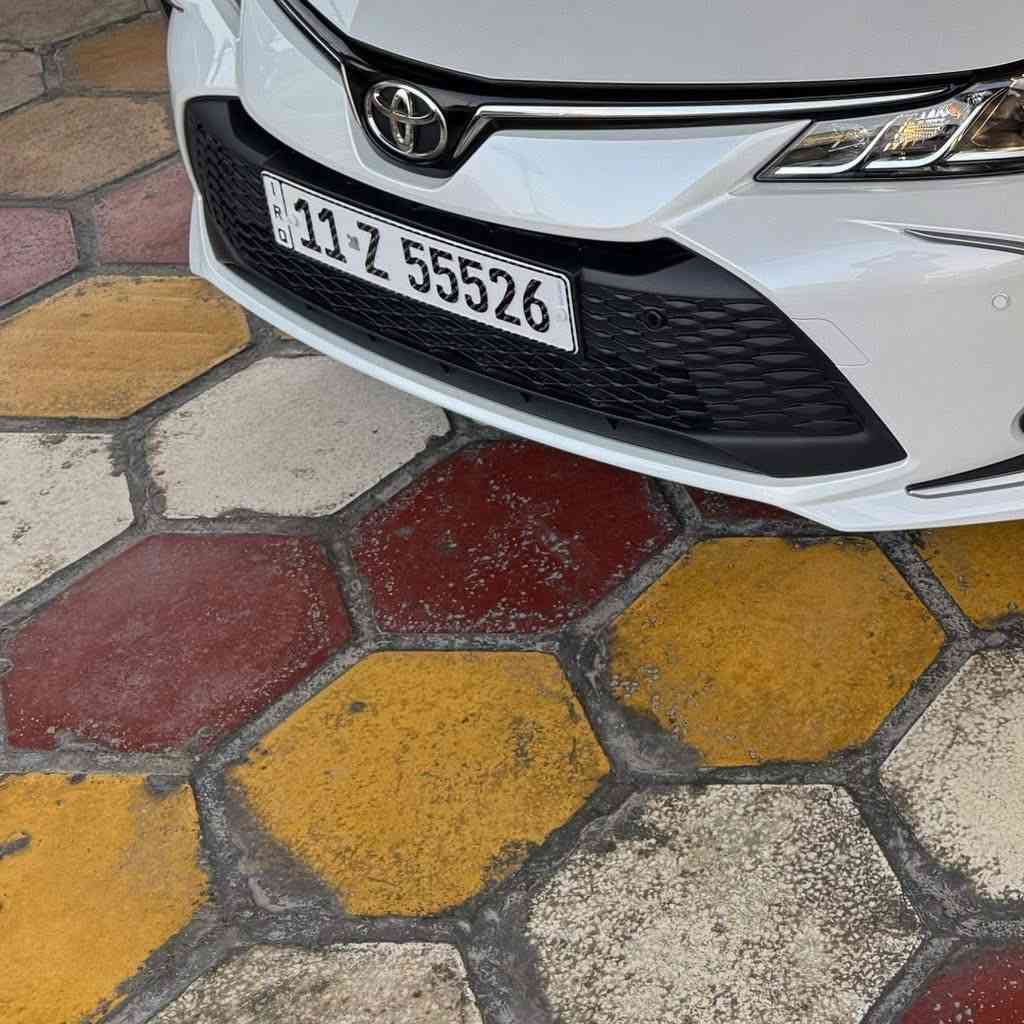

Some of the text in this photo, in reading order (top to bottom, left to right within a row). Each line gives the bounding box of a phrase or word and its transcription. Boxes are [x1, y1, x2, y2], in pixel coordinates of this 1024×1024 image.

[294, 198, 551, 334] 11 Z 55526
